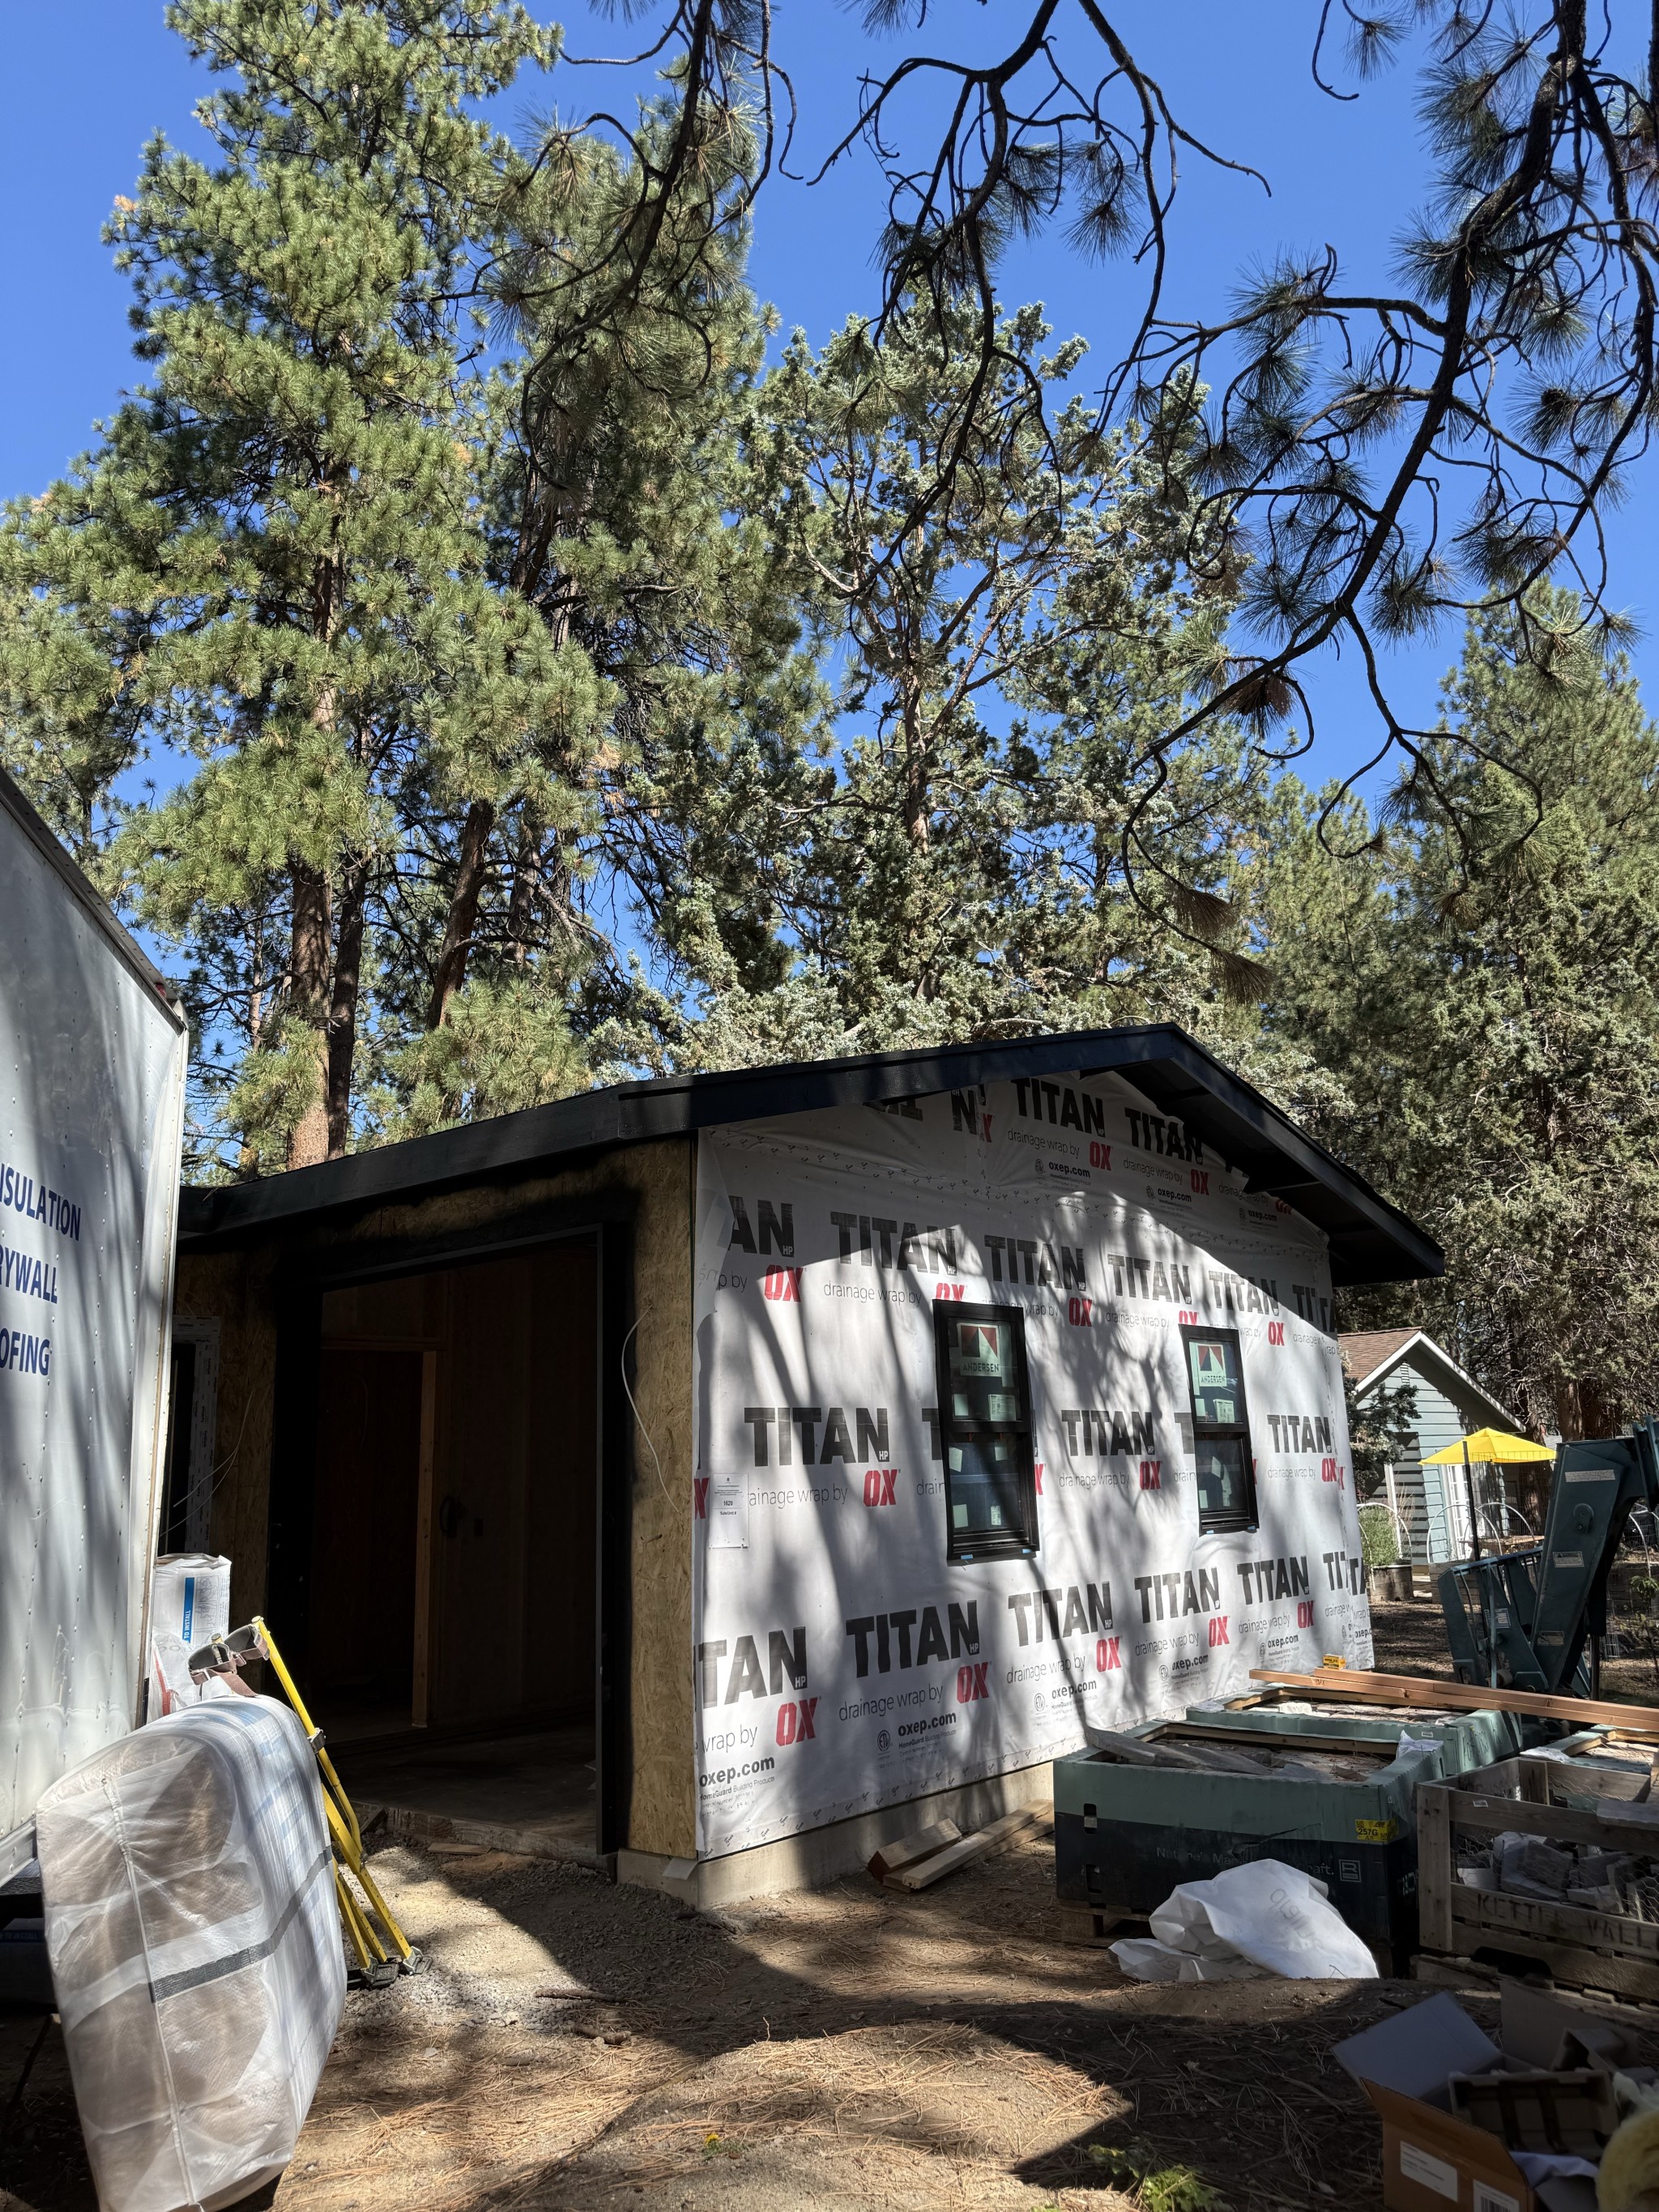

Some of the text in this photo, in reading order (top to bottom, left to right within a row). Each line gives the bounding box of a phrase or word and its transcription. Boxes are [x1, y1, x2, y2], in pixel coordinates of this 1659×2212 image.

[1011, 1077, 1106, 1138] TITAN
[1008, 1127, 1111, 1171] drainage wrap by OX
[1049, 1162, 1090, 1178] oxep.com
[1124, 1157, 1154, 1178] drainage
[1191, 1169, 1209, 1196] OX
[1158, 1187, 1192, 1202] oxep.com
[783, 1245, 794, 1255] HP
[830, 1211, 957, 1276] TITAN
[984, 1234, 1086, 1291] TITAN
[1107, 1254, 1192, 1305] TITAN
[731, 1270, 748, 1293] by
[765, 1264, 804, 1302] OX
[824, 1280, 875, 1303] drainage
[878, 1289, 906, 1306] wrap
[907, 1288, 922, 1309] by
[1209, 1271, 1279, 1316] TITAN
[1069, 1298, 1092, 1328] OX
[1105, 1311, 1140, 1328] drainage
[1268, 1321, 1285, 1346] OX
[962, 1362, 1000, 1373] ANDERSEN
[1201, 1375, 1226, 1383] ANDERSEN
[744, 1407, 889, 1467] TITAN
[1061, 1409, 1155, 1456] TITAN
[1267, 1414, 1333, 1453] TITAN
[879, 1450, 889, 1460] HP
[1321, 1458, 1337, 1482] OX
[748, 1487, 795, 1510] ainage
[798, 1488, 830, 1506] wrap
[833, 1484, 848, 1505] by
[864, 1468, 898, 1507] OX
[1059, 1473, 1096, 1490] drainage
[1098, 1474, 1119, 1489] wrap
[1140, 1460, 1161, 1490] OX
[1134, 1566, 1220, 1624] TITAN
[1237, 1555, 1309, 1605] TITAN
[1008, 1581, 1113, 1647] TITAN
[1238, 1618, 1267, 1634] drainage
[1297, 1600, 1315, 1629] OX
[846, 1600, 980, 1679] TITAN
[969, 1643, 979, 1654] HP
[1135, 1615, 1230, 1656] drainage wrap by OX
[1267, 1634, 1299, 1649] oxep.com
[695, 1626, 808, 1710] TAN
[1006, 1635, 1122, 1684] drainage wrap by OX
[1172, 1654, 1209, 1671] oxep.com
[795, 1675, 807, 1688] HP
[838, 1661, 990, 1721] drainage wrap by OX
[1051, 1680, 1097, 1699] oxep.com
[740, 1724, 758, 1748] by
[776, 1696, 818, 1747] OX
[898, 1712, 957, 1737] oxep.com
[699, 1756, 775, 1788] oxep.com
[1358, 1828, 1379, 1836] 257G
